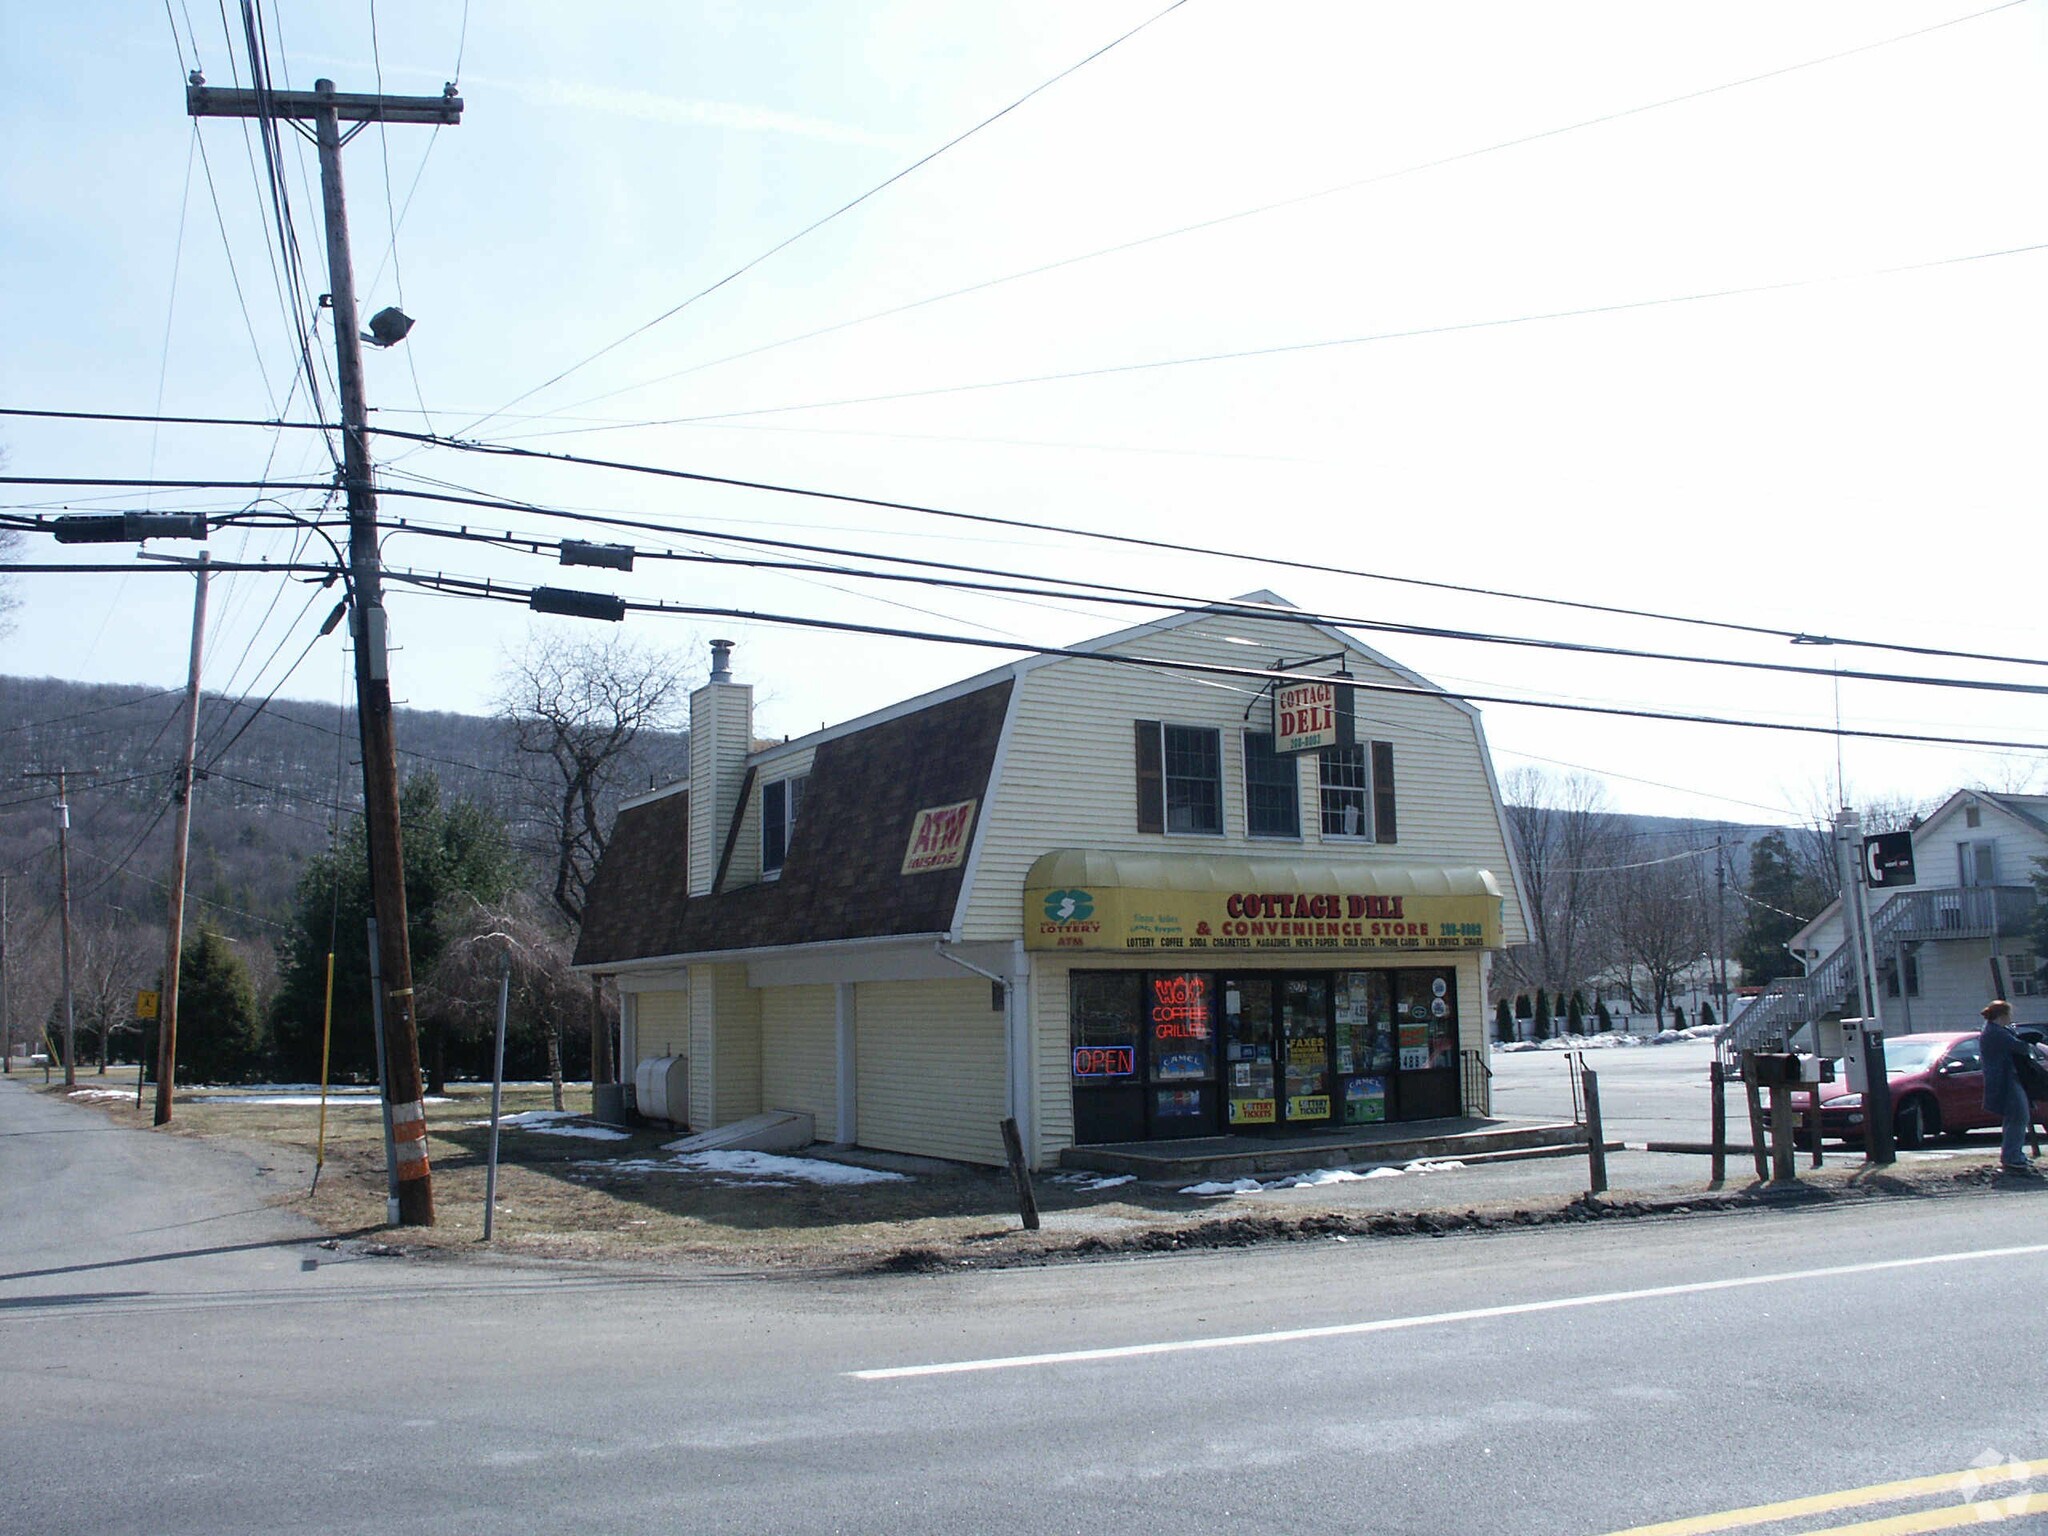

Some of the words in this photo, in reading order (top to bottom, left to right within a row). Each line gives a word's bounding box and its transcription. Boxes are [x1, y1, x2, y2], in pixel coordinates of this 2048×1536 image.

[1280, 684, 1331, 709] COTTAGE
[1280, 704, 1332, 737] DELI
[912, 805, 969, 854] ATM
[908, 851, 958, 868] INSIDE
[1227, 893, 1341, 919] COTTAGE
[1346, 895, 1404, 919] DELI
[1040, 925, 1100, 934] LOTTERY
[1196, 921, 1212, 936] &
[1222, 921, 1362, 936] CONVENIENCE
[1371, 922, 1429, 936] STORE
[1057, 937, 1084, 946] ATM
[1127, 937, 1154, 947] LOTTERY
[1160, 937, 1184, 947] COFFEE
[1189, 937, 1207, 947] SODA
[1213, 938, 1251, 947] CIGARETTES
[1256, 938, 1291, 947] MAGAZINES
[1295, 938, 1313, 947] NEWS
[1315, 938, 1339, 947] PAPERS
[1343, 938, 1358, 947] COLD
[1360, 938, 1375, 947] CUTS
[1380, 938, 1398, 947] PHONE
[1401, 938, 1419, 947] CARDS
[1152, 1007, 1208, 1022] COFFEE
[1289, 1038, 1325, 1049] FAXES
[1076, 1050, 1133, 1074] OPEN
[1163, 1055, 1201, 1067] CAMEL
[1349, 1078, 1382, 1089] CAMEL
[1242, 1102, 1272, 1110] LOTTERY
[1298, 1099, 1327, 1107] LOTTERY
[1243, 1110, 1272, 1118] TICKETS
[1300, 1107, 1327, 1115] TICKETS
